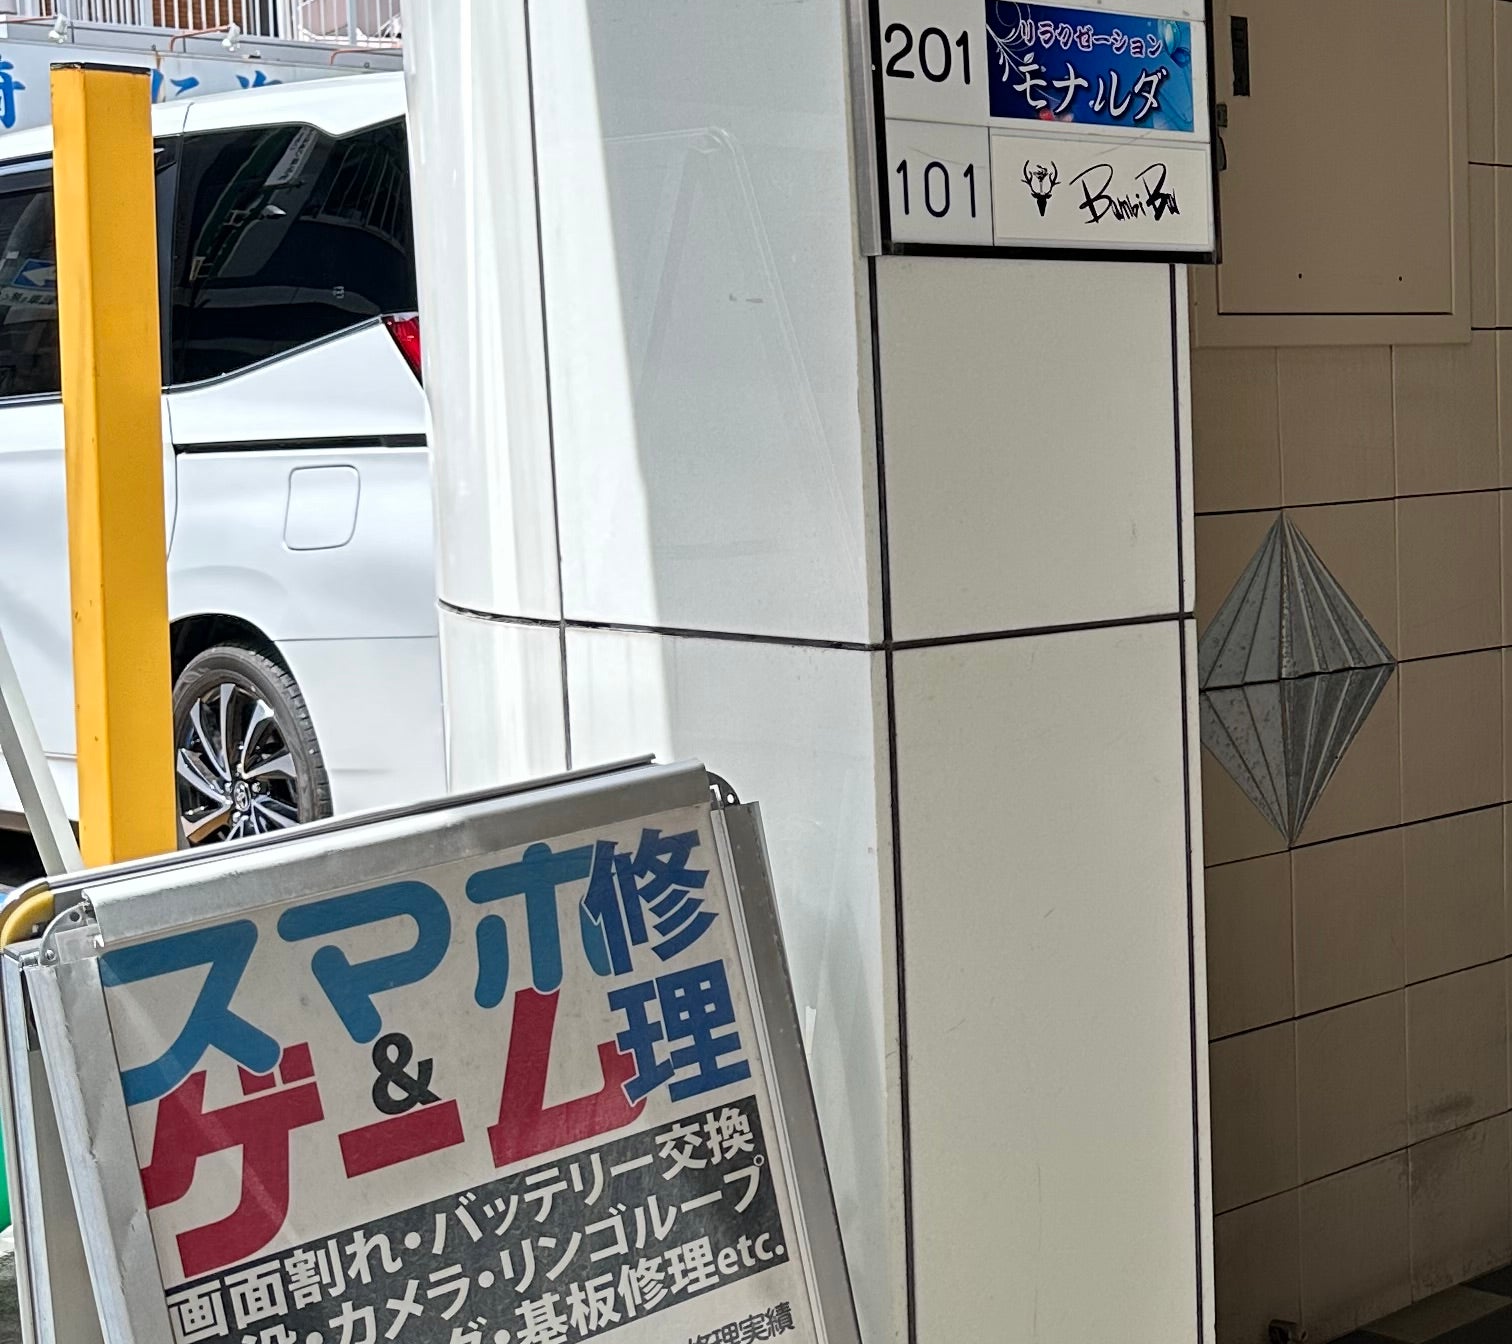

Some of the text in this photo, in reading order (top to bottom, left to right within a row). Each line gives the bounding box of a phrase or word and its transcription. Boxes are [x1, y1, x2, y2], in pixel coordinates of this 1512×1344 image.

[884, 22, 971, 85] 201
[1020, 19, 1162, 58] リラクゼーション
[1013, 60, 1168, 120] モナルダ
[896, 160, 976, 219] 101
[100, 842, 612, 1106] スマホ
[580, 828, 751, 1108] 修理
[372, 1032, 442, 1115] &
[141, 987, 647, 1277] ゲーム
